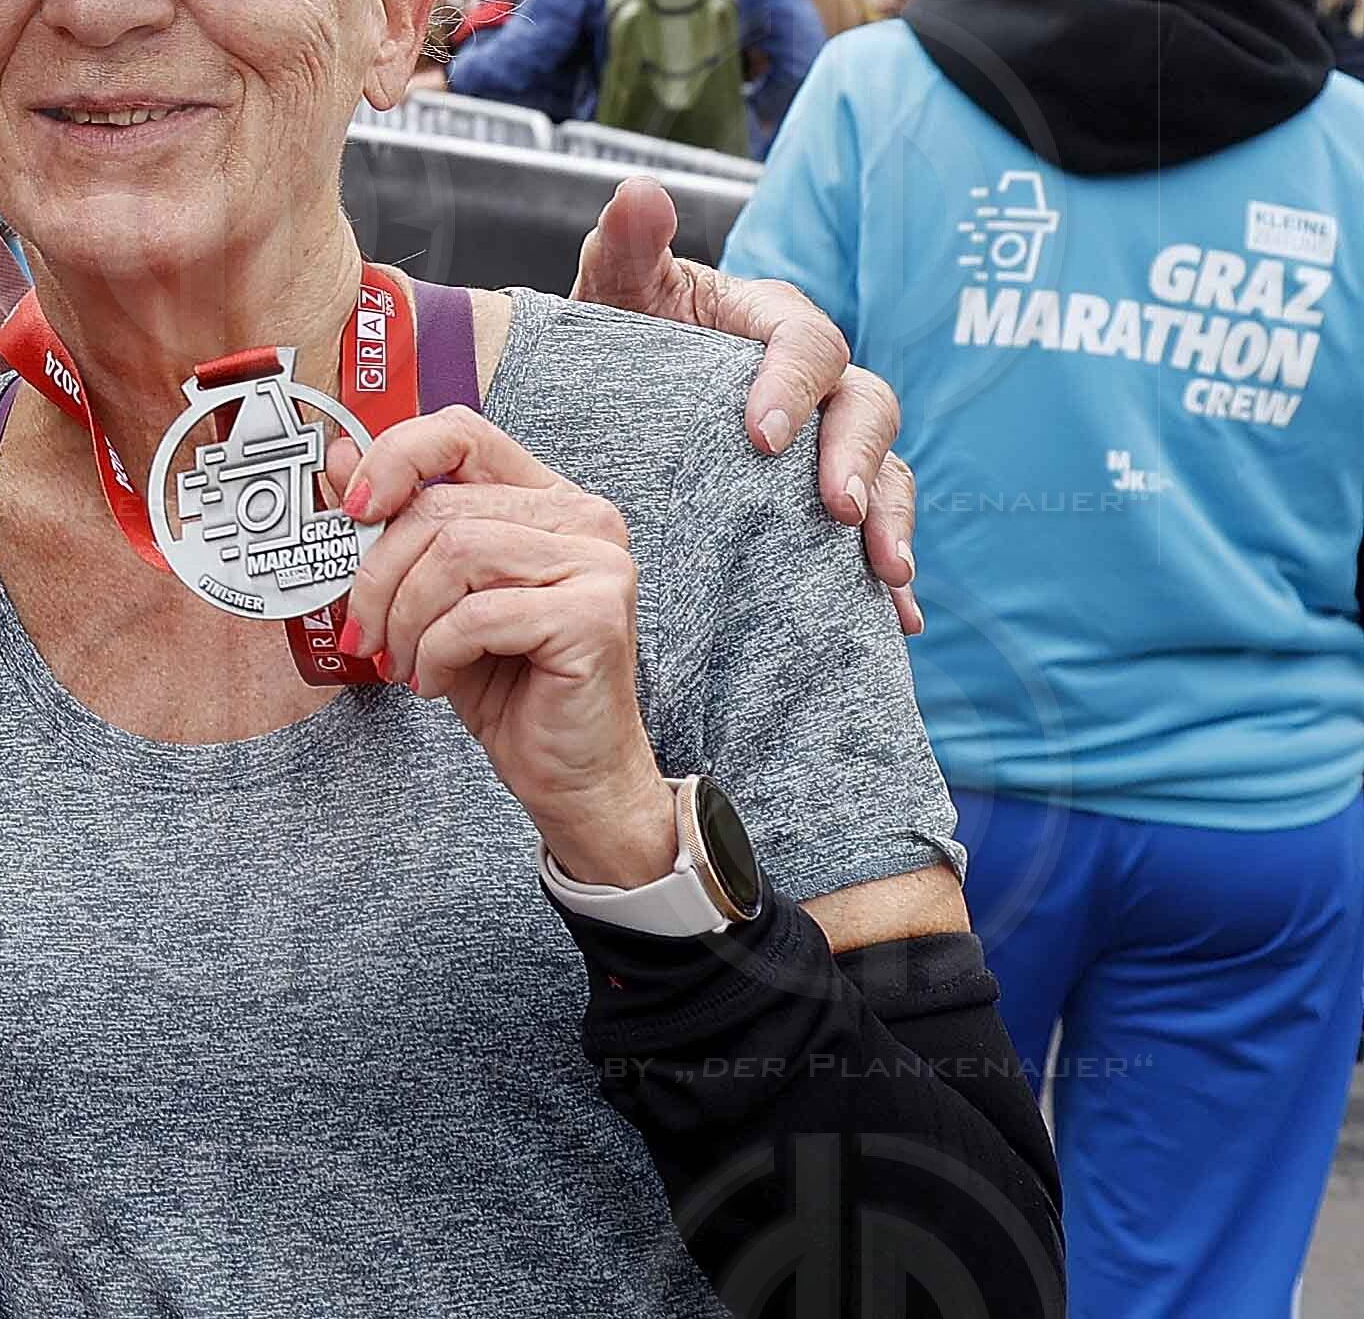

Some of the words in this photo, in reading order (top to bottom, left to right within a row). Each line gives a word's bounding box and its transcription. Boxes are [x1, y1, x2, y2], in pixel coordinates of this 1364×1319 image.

[1148, 242, 1333, 327] GRAZ
[358, 287, 385, 390] GRAZ
[953, 286, 1321, 391] MARATHON
[1183, 377, 1302, 429] CREW
[301, 517, 355, 543] GRAZ
[247, 535, 358, 576] MARATHON
[312, 555, 360, 581] 2024
[198, 575, 265, 611] FINISHER
